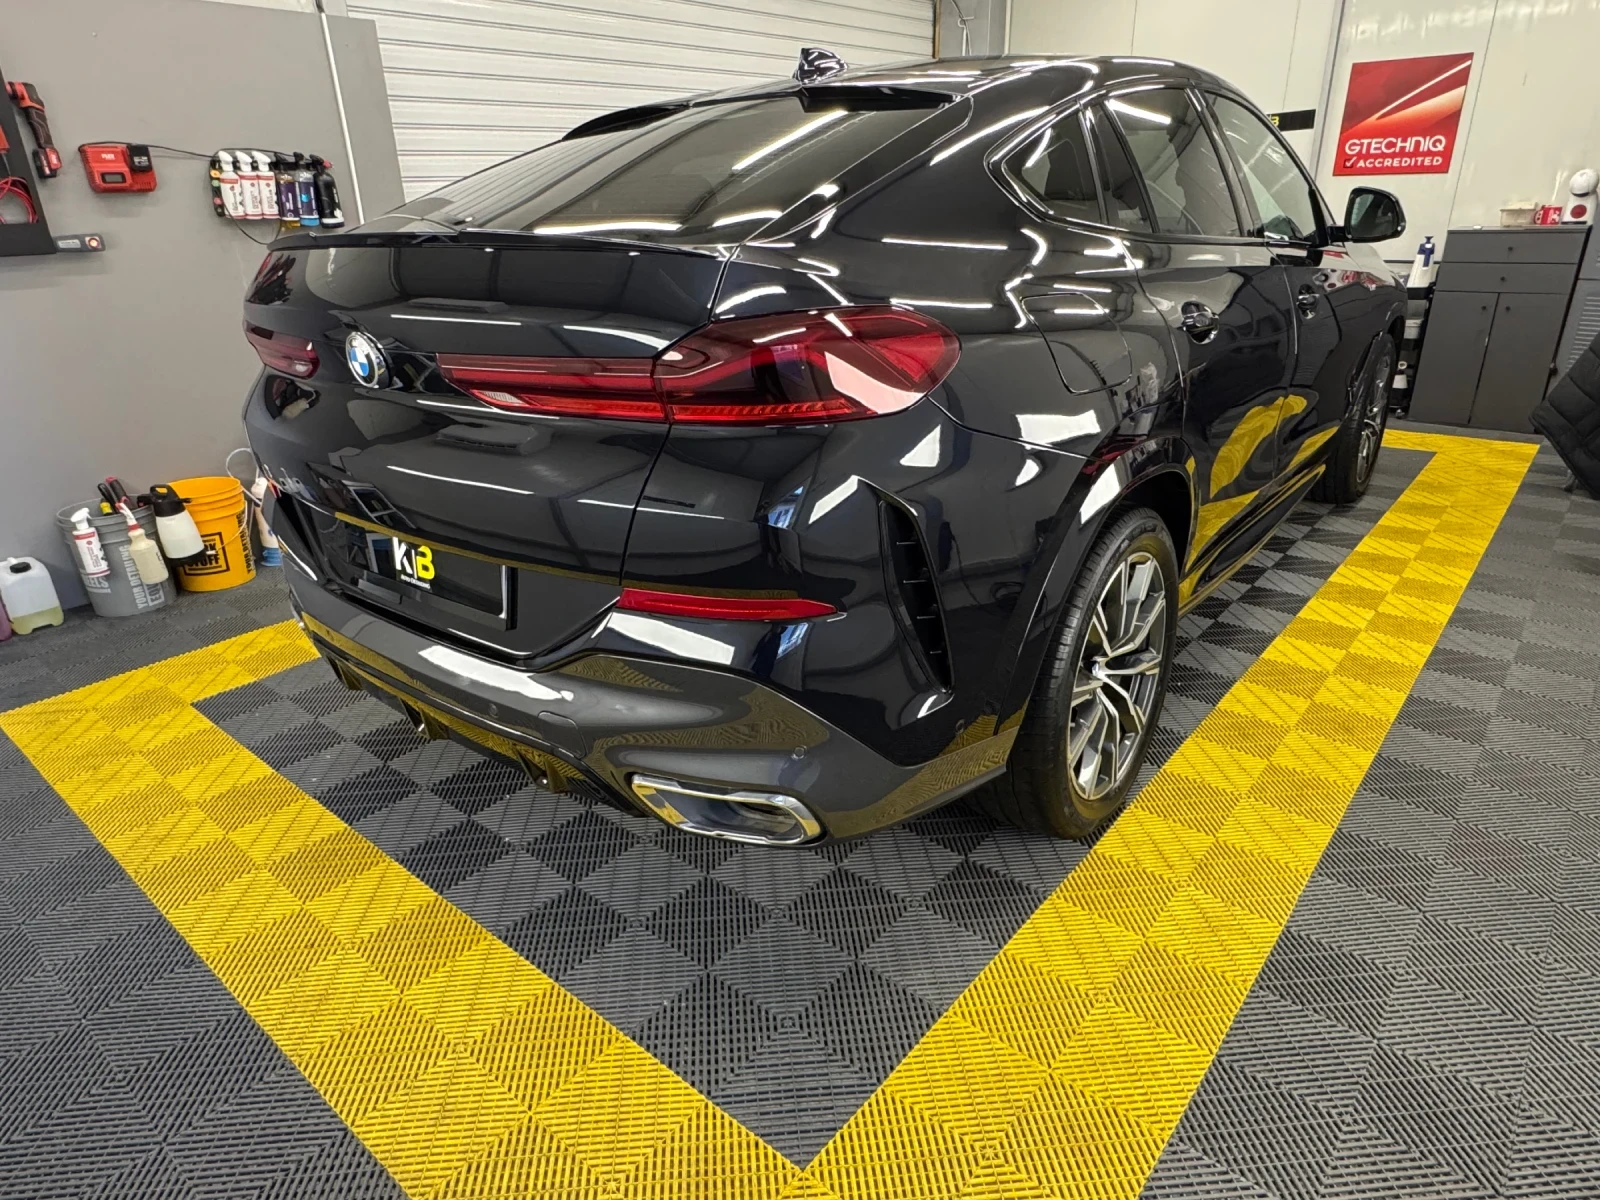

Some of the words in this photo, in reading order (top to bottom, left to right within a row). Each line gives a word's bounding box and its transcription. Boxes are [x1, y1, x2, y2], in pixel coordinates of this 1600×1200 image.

[1345, 135, 1446, 155] GTECHNIQ
[1356, 156, 1442, 168] ACCREDITED
[133, 588, 149, 609] YOUR
